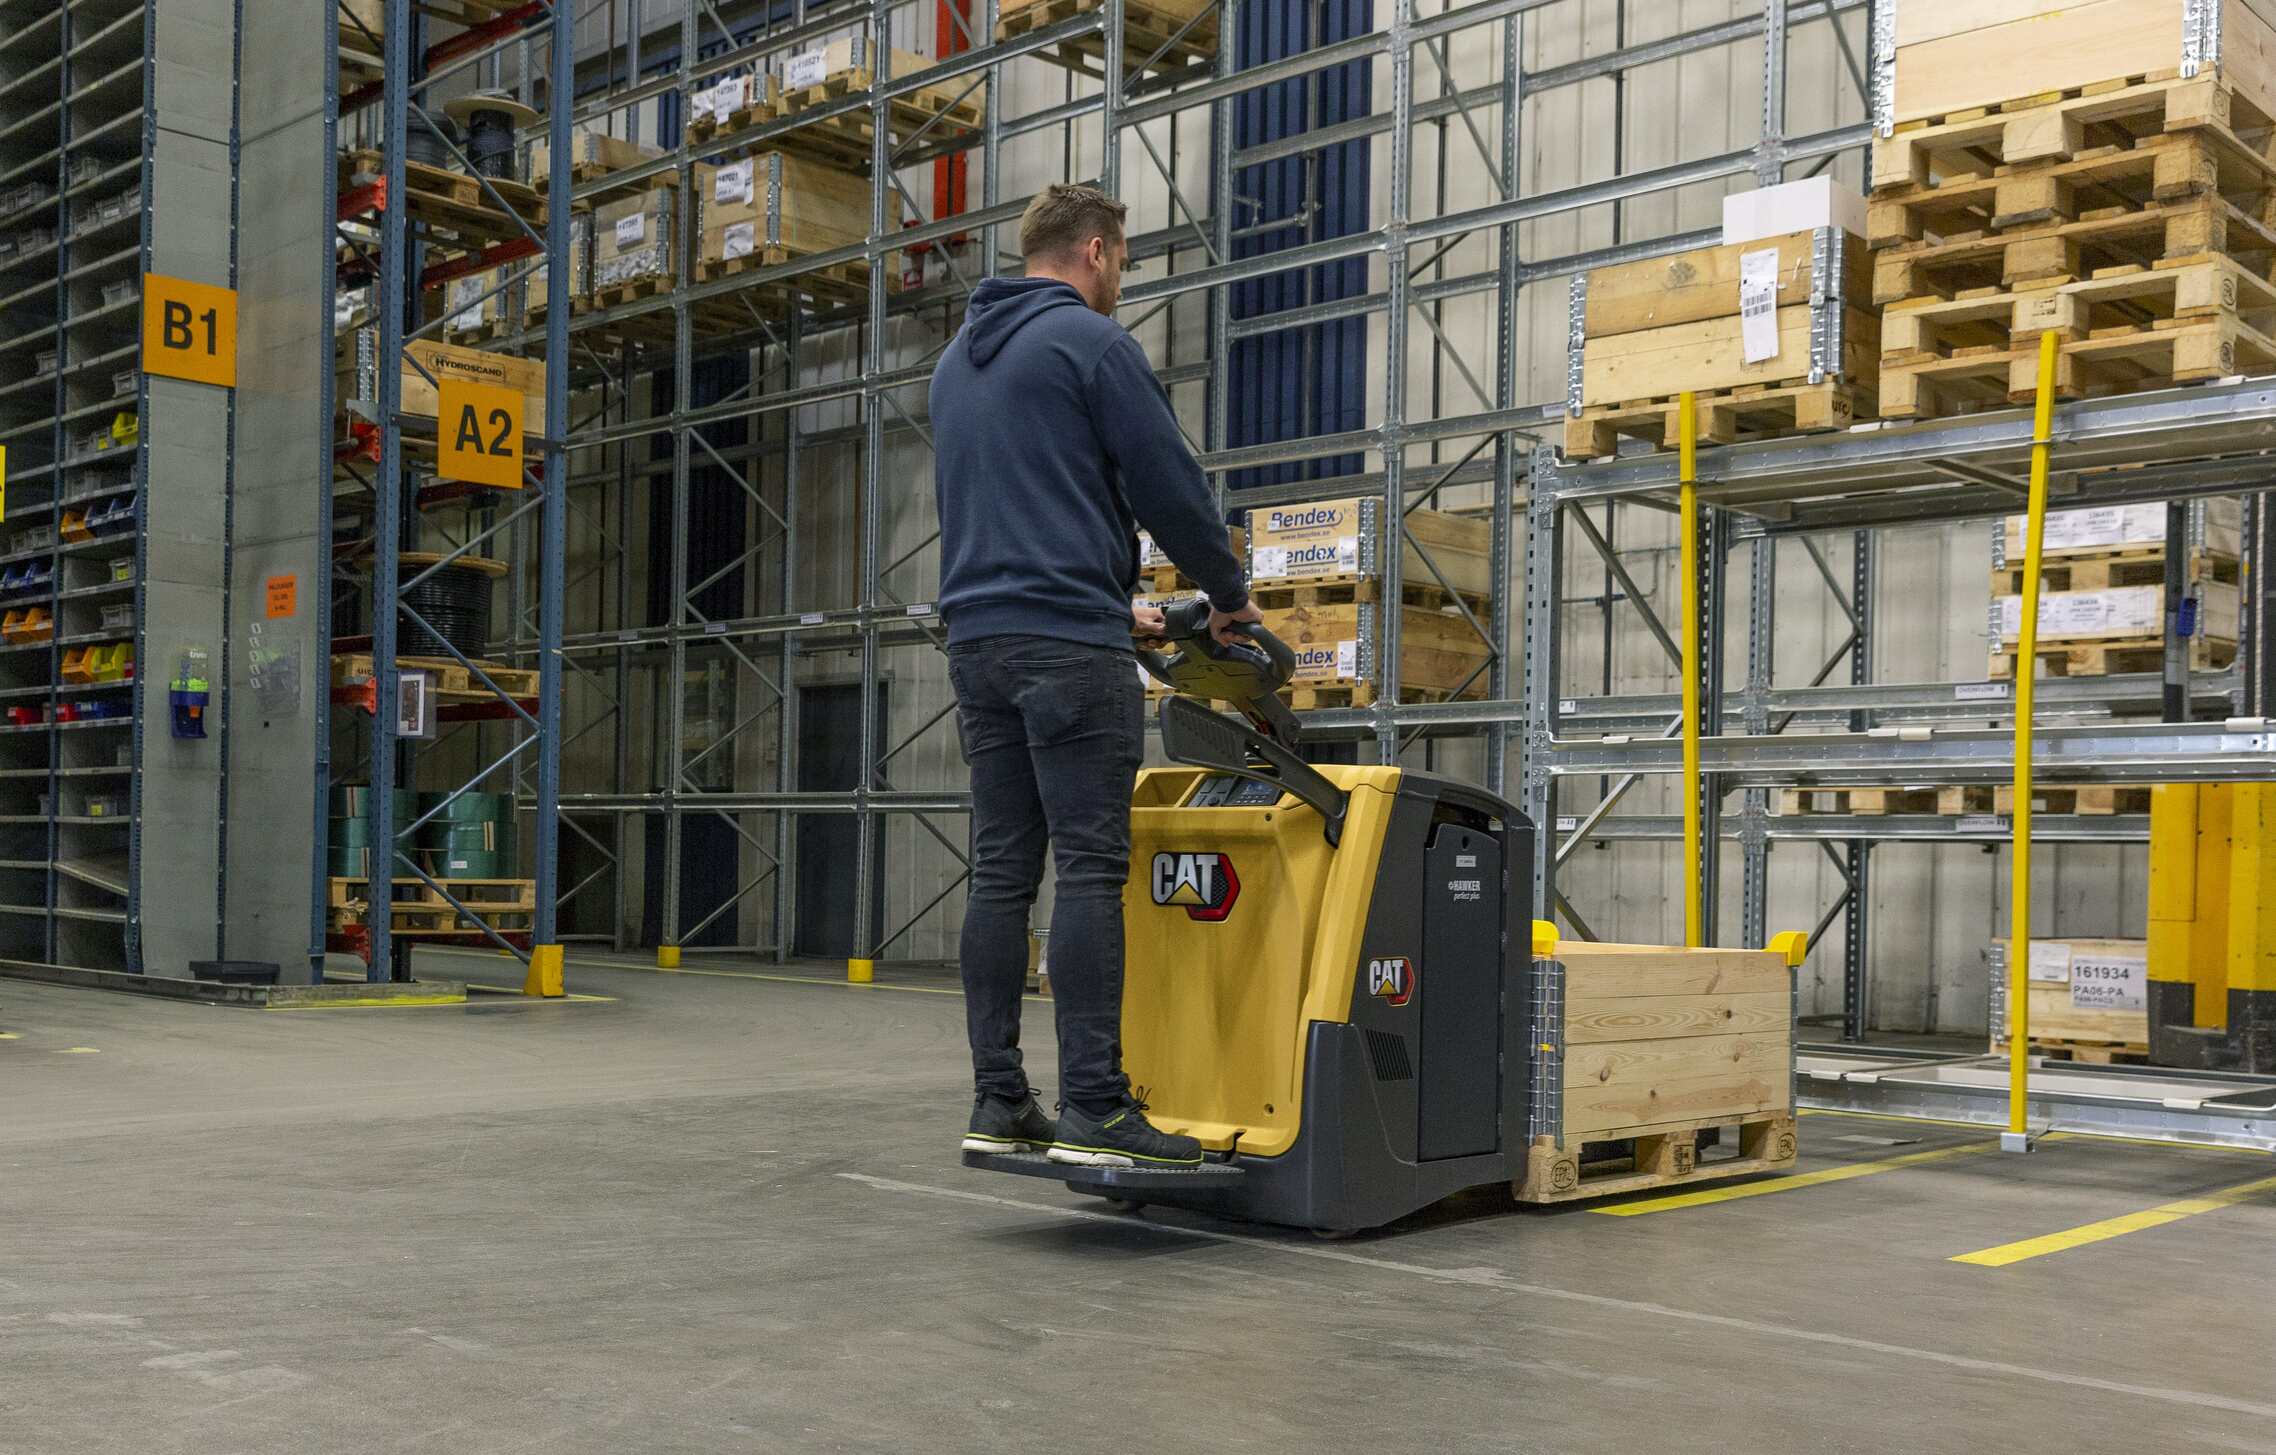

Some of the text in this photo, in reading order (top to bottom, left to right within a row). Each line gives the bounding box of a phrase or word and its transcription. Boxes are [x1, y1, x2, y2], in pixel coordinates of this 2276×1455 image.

[164, 300, 217, 355] B1
[435, 357, 502, 377] HYDROSCAND
[455, 404, 512, 457] A2
[1286, 544, 1336, 564] endex
[1295, 647, 1334, 665] ndex
[1153, 853, 1218, 904] CAT
[1370, 960, 1403, 995] CAT
[2075, 966, 2129, 980] 161934
